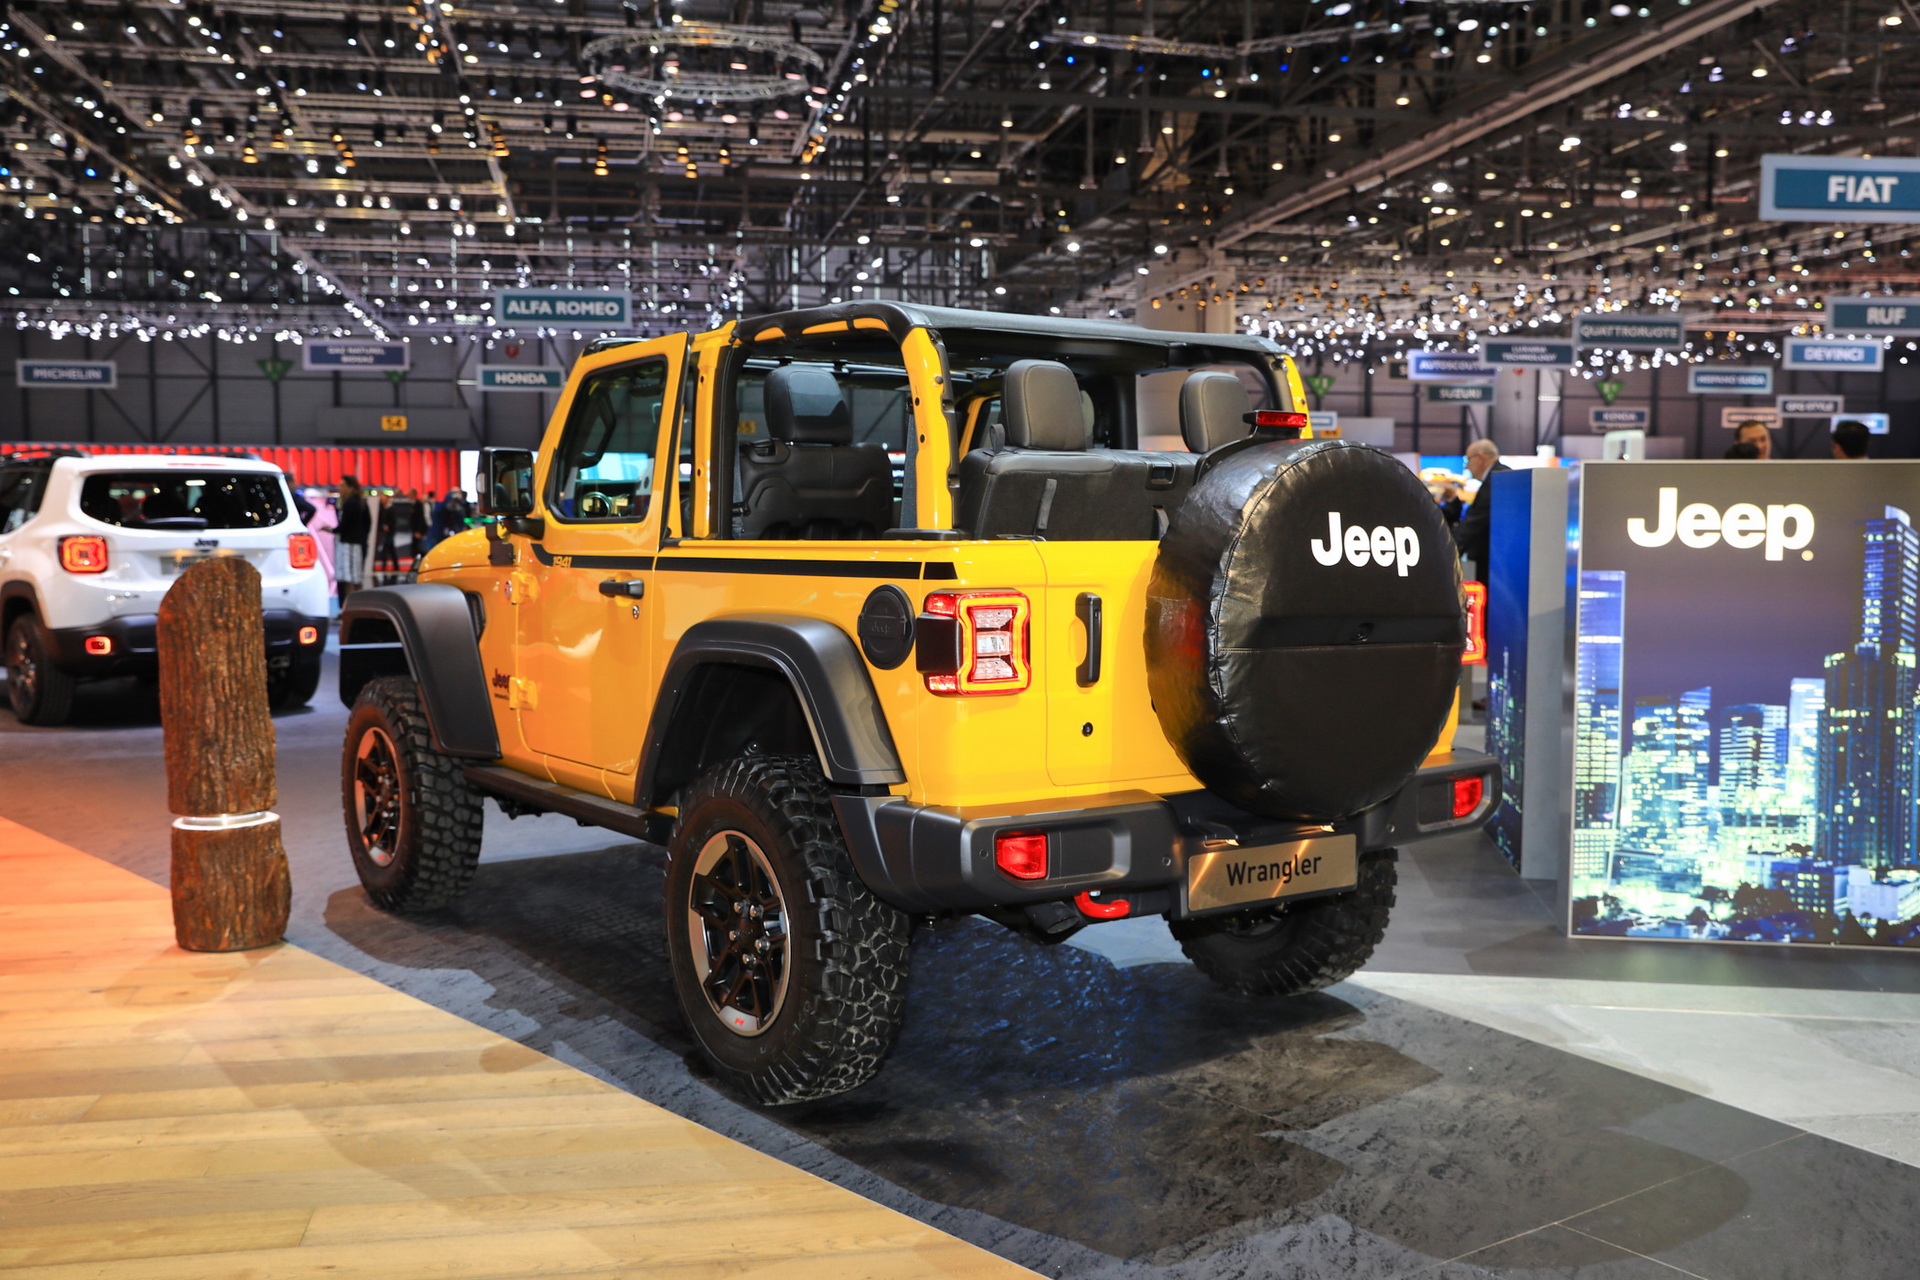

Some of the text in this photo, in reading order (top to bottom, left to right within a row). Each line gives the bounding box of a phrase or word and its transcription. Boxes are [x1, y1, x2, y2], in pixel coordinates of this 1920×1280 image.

[1827, 174, 1899, 204] FIAT
[507, 299, 620, 317] ALFA ROMEO
[1866, 306, 1906, 326] RUF
[1580, 323, 1679, 339] QUATTRORUOTE
[1803, 346, 1865, 362] DEVINCI
[32, 367, 103, 381] MICHELIN
[494, 372, 548, 386] HONDA
[1438, 387, 1483, 400] SUZUKI
[1311, 511, 1421, 577] Jeep
[552, 556, 573, 569] 1941
[871, 620, 891, 636] Jeep
[1225, 853, 1322, 887] Wrangler
